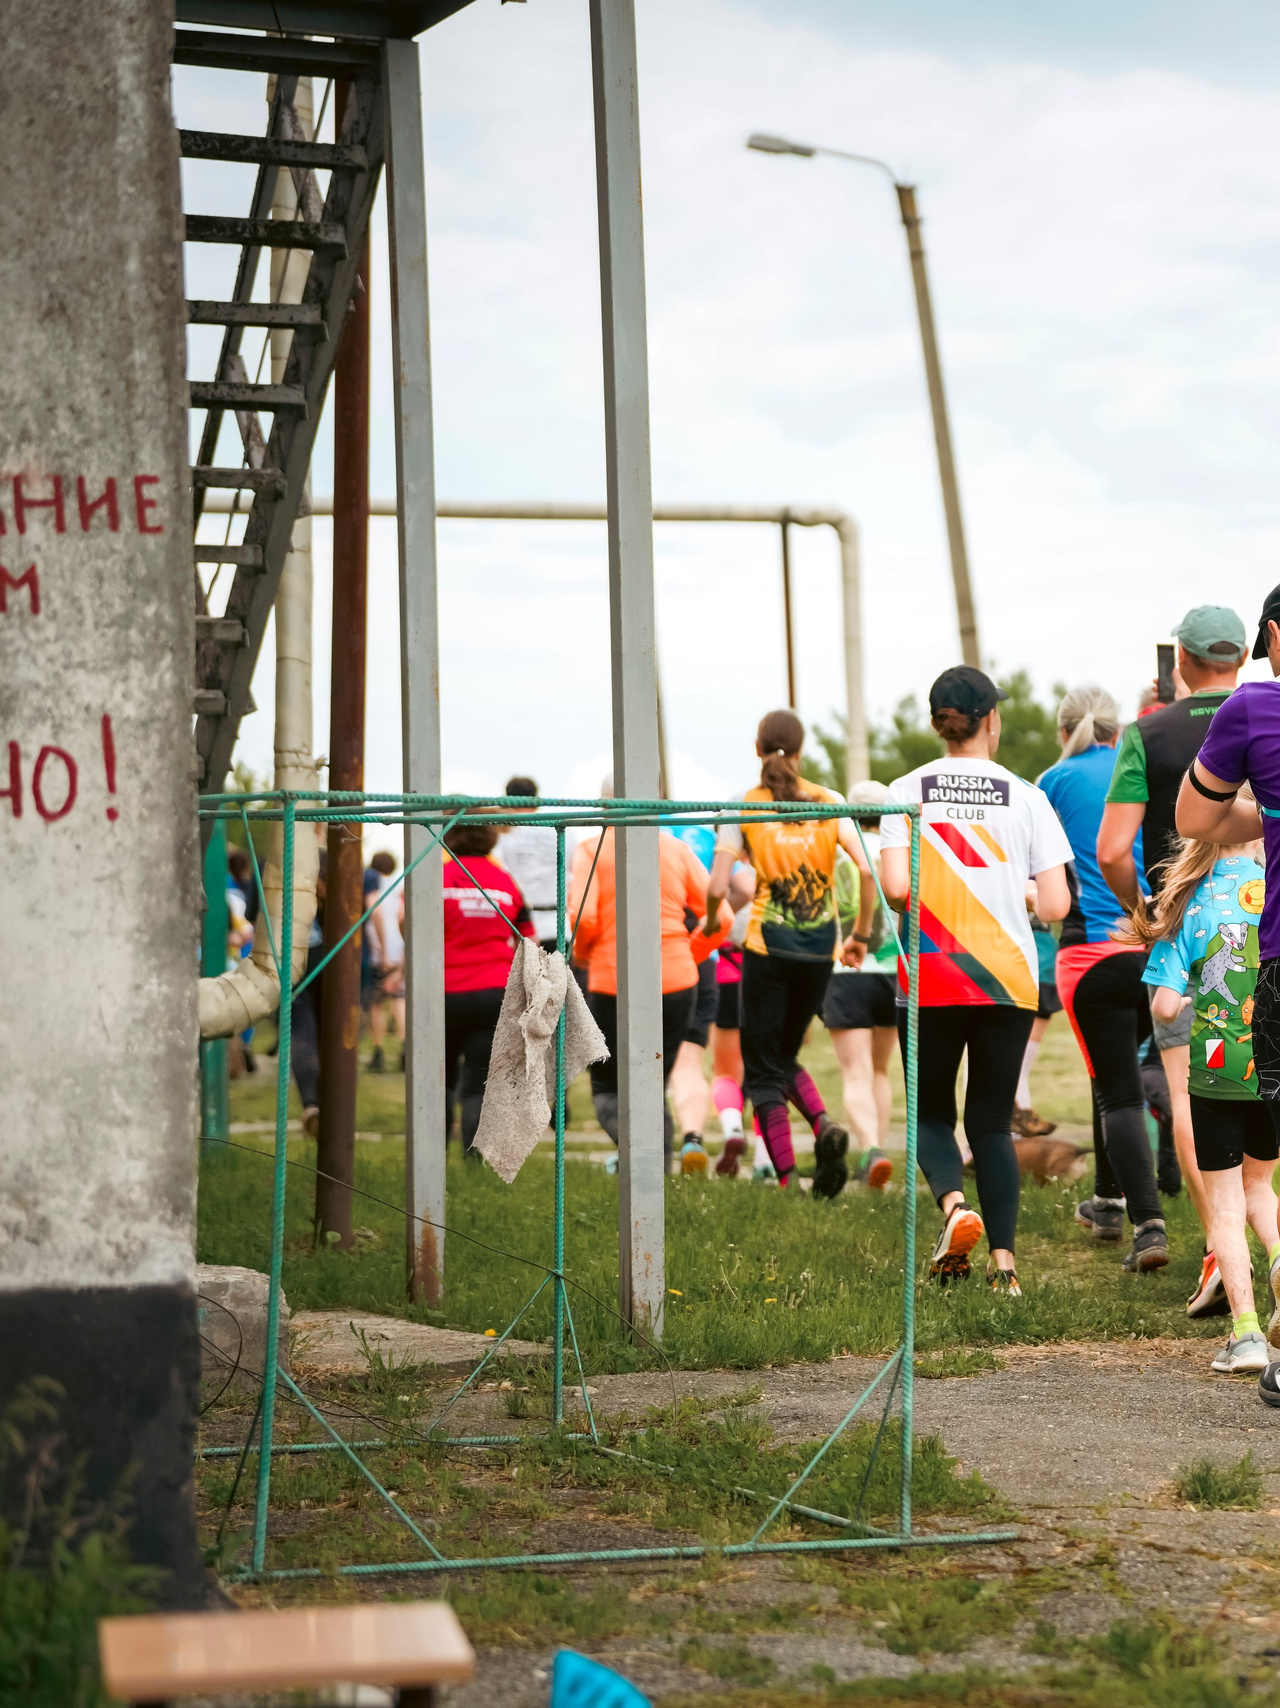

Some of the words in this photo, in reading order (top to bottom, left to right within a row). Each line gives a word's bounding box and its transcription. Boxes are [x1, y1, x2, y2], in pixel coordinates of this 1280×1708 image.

[0, 474, 164, 534] НИЕ
[936, 775, 994, 790] RUSSIA
[928, 788, 1003, 804] RUNNING
[946, 807, 985, 820] CLUB
